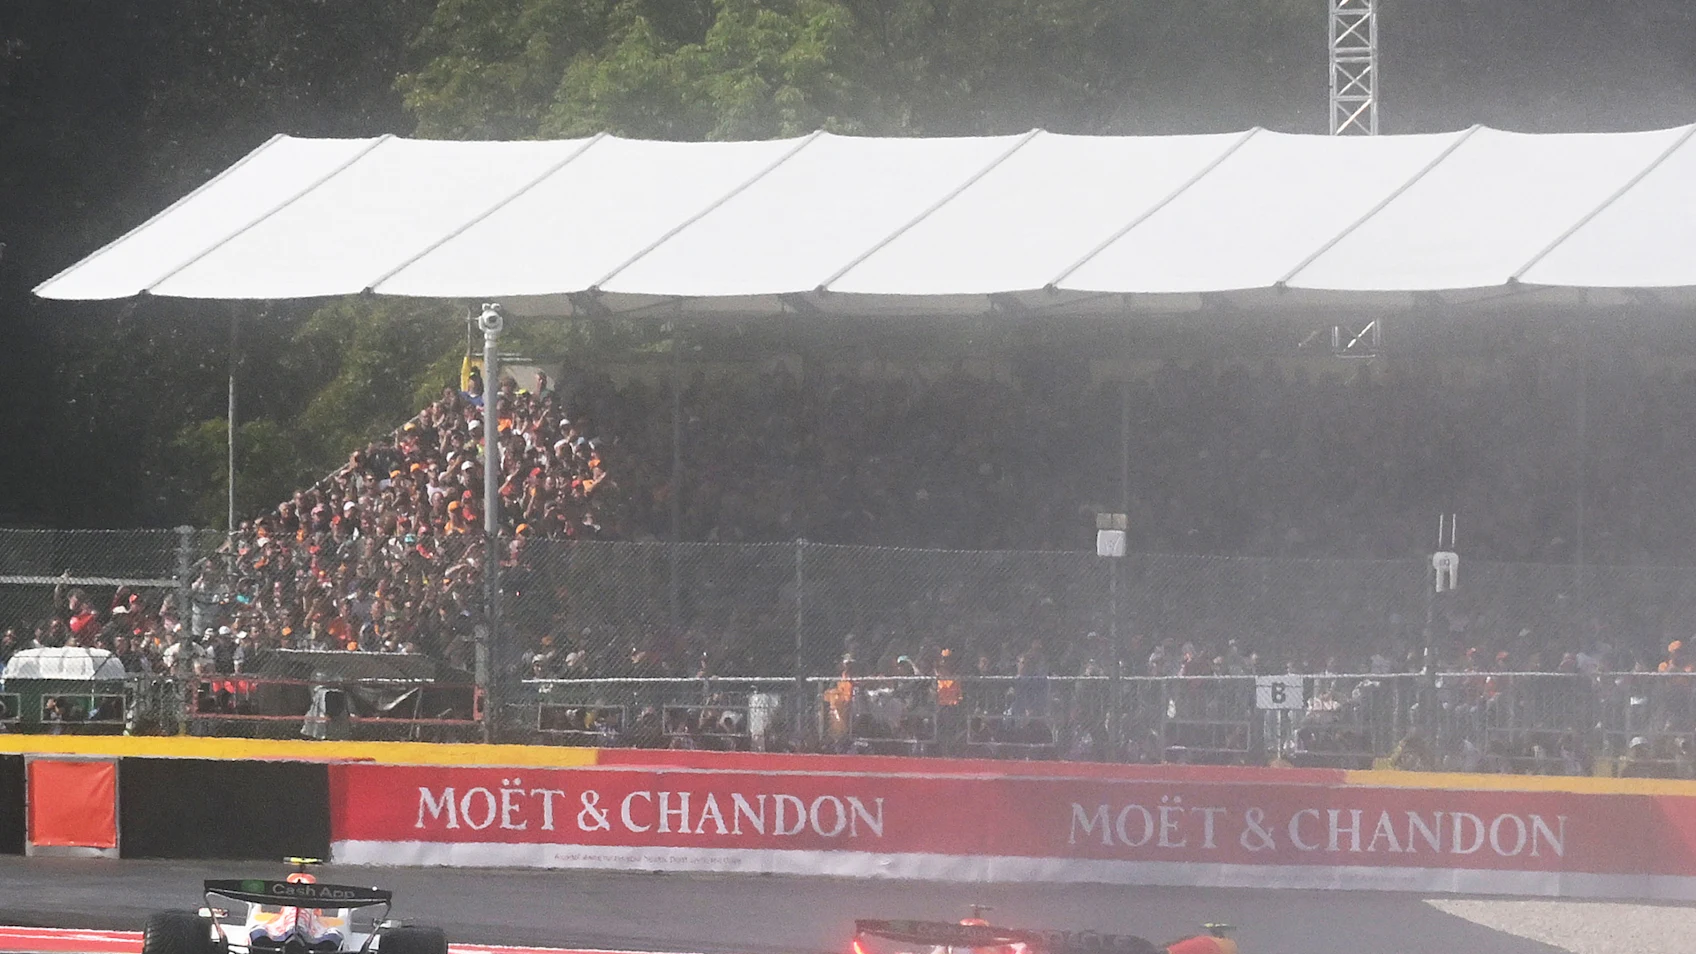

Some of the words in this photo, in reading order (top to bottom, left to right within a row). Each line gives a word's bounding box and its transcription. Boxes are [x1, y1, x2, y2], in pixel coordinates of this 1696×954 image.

[1271, 682, 1287, 704] B
[415, 778, 564, 831] MOËT
[577, 790, 609, 832] &
[621, 791, 884, 837] CHANDON
[1068, 795, 1226, 849] MOËT
[1240, 808, 1276, 851] &
[1290, 809, 1568, 857] CHANDON
[273, 883, 315, 896] Cash
[319, 888, 356, 899] App
